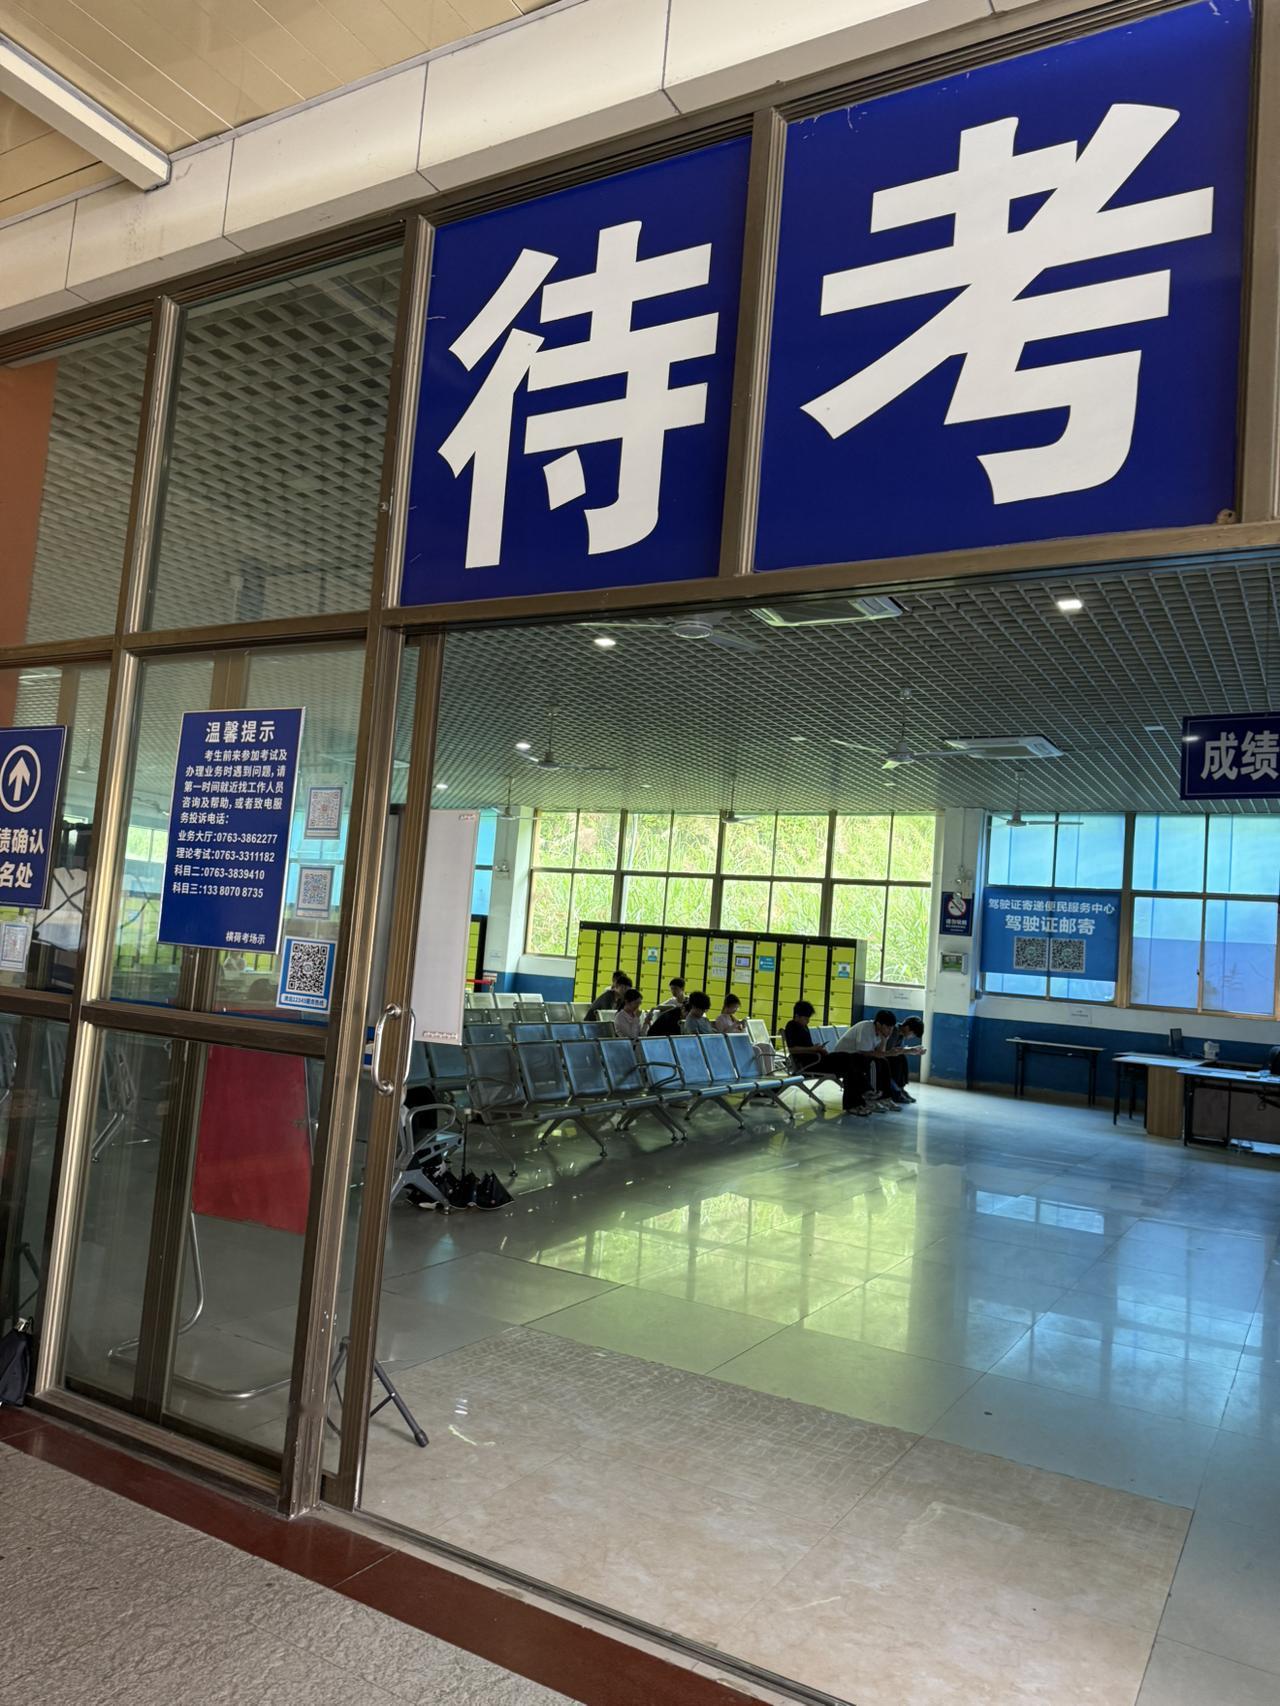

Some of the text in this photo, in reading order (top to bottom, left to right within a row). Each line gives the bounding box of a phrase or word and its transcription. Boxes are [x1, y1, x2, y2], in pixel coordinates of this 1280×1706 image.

[437, 103, 1214, 569] 待考
[205, 720, 275, 743] 温馨提示
[204, 748, 288, 762] 考生前来参加考试及
[1200, 730, 1280, 780] 成绩
[183, 780, 284, 794] 第一时间就近找工作人员
[178, 830, 278, 844] 业务大厅:0763-3862277
[176, 847, 275, 862] 理论考试:0763-3311182
[174, 864, 265, 880] 科目二:0763-3839410
[219, 885, 241, 897] 8070
[241, 887, 264, 899] 8735
[988, 898, 1115, 914] 驾驶证寄递便民服务中心
[1005, 915, 1096, 935] 驾驶证邮寄
